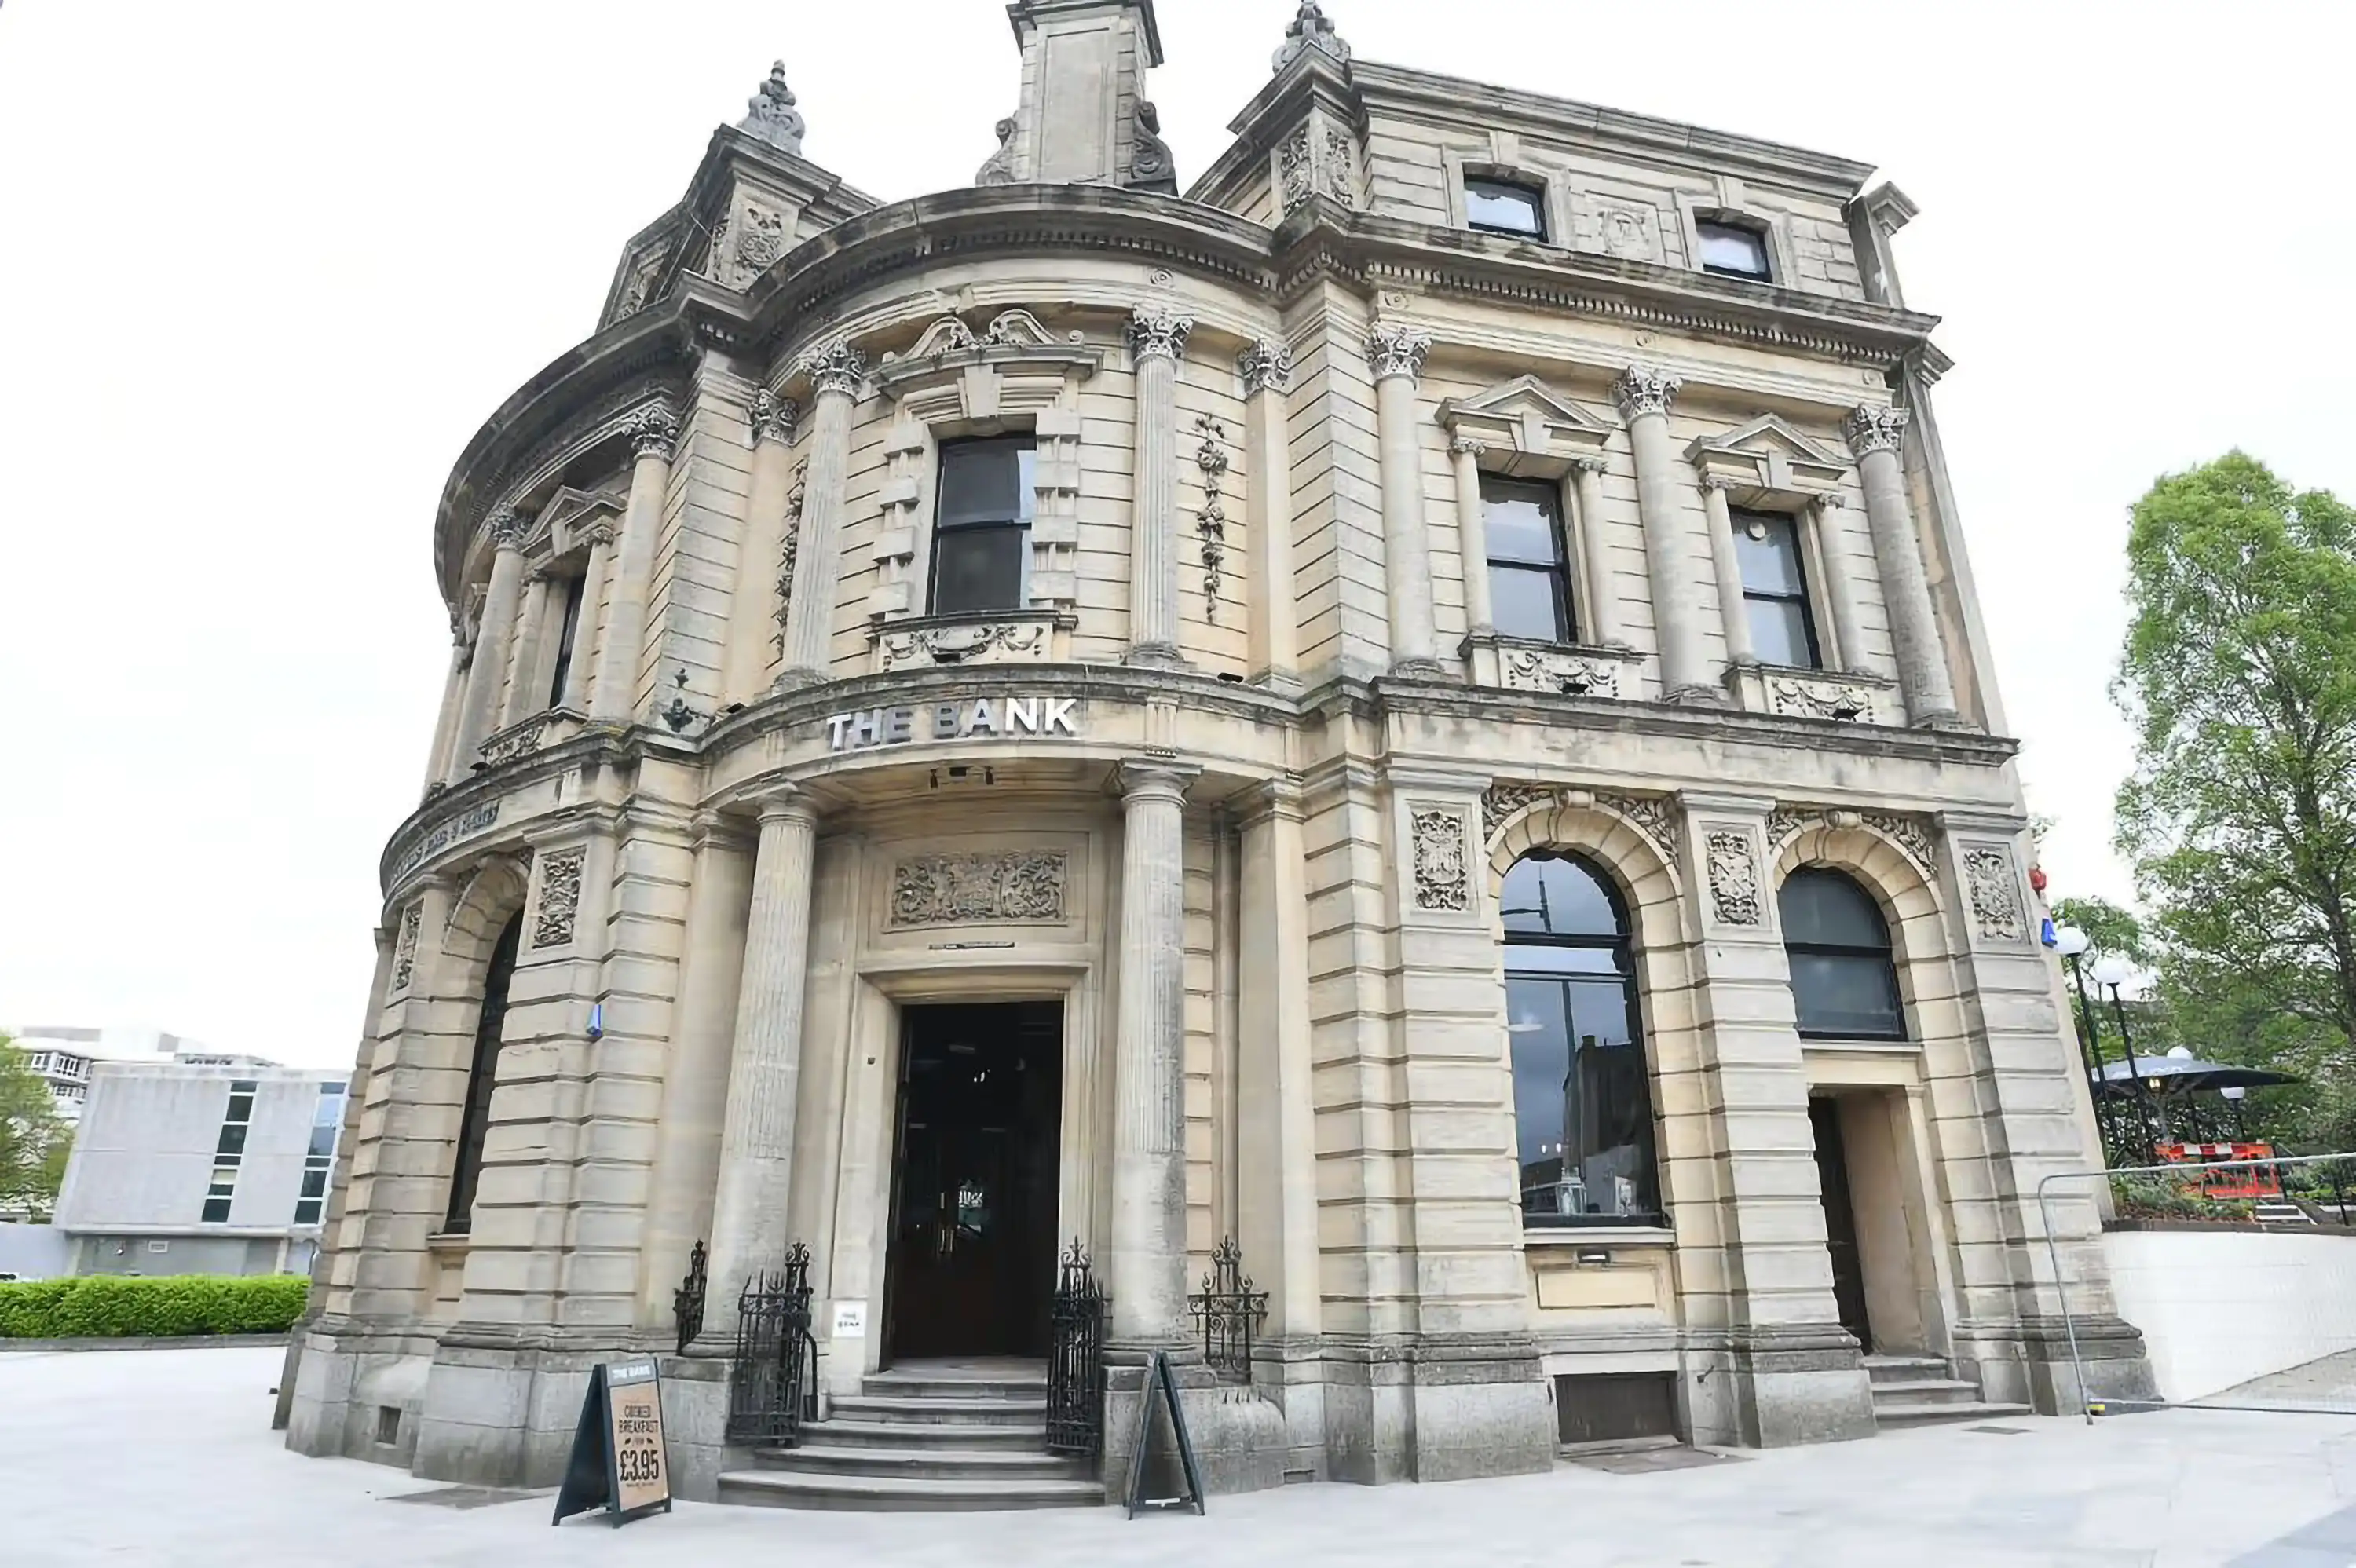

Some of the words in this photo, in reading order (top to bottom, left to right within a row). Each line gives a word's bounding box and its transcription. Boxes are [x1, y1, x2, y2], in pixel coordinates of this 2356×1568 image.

[826, 707, 913, 751] THE
[933, 697, 1078, 739] BANK
[620, 1449, 659, 1482] £3.95
